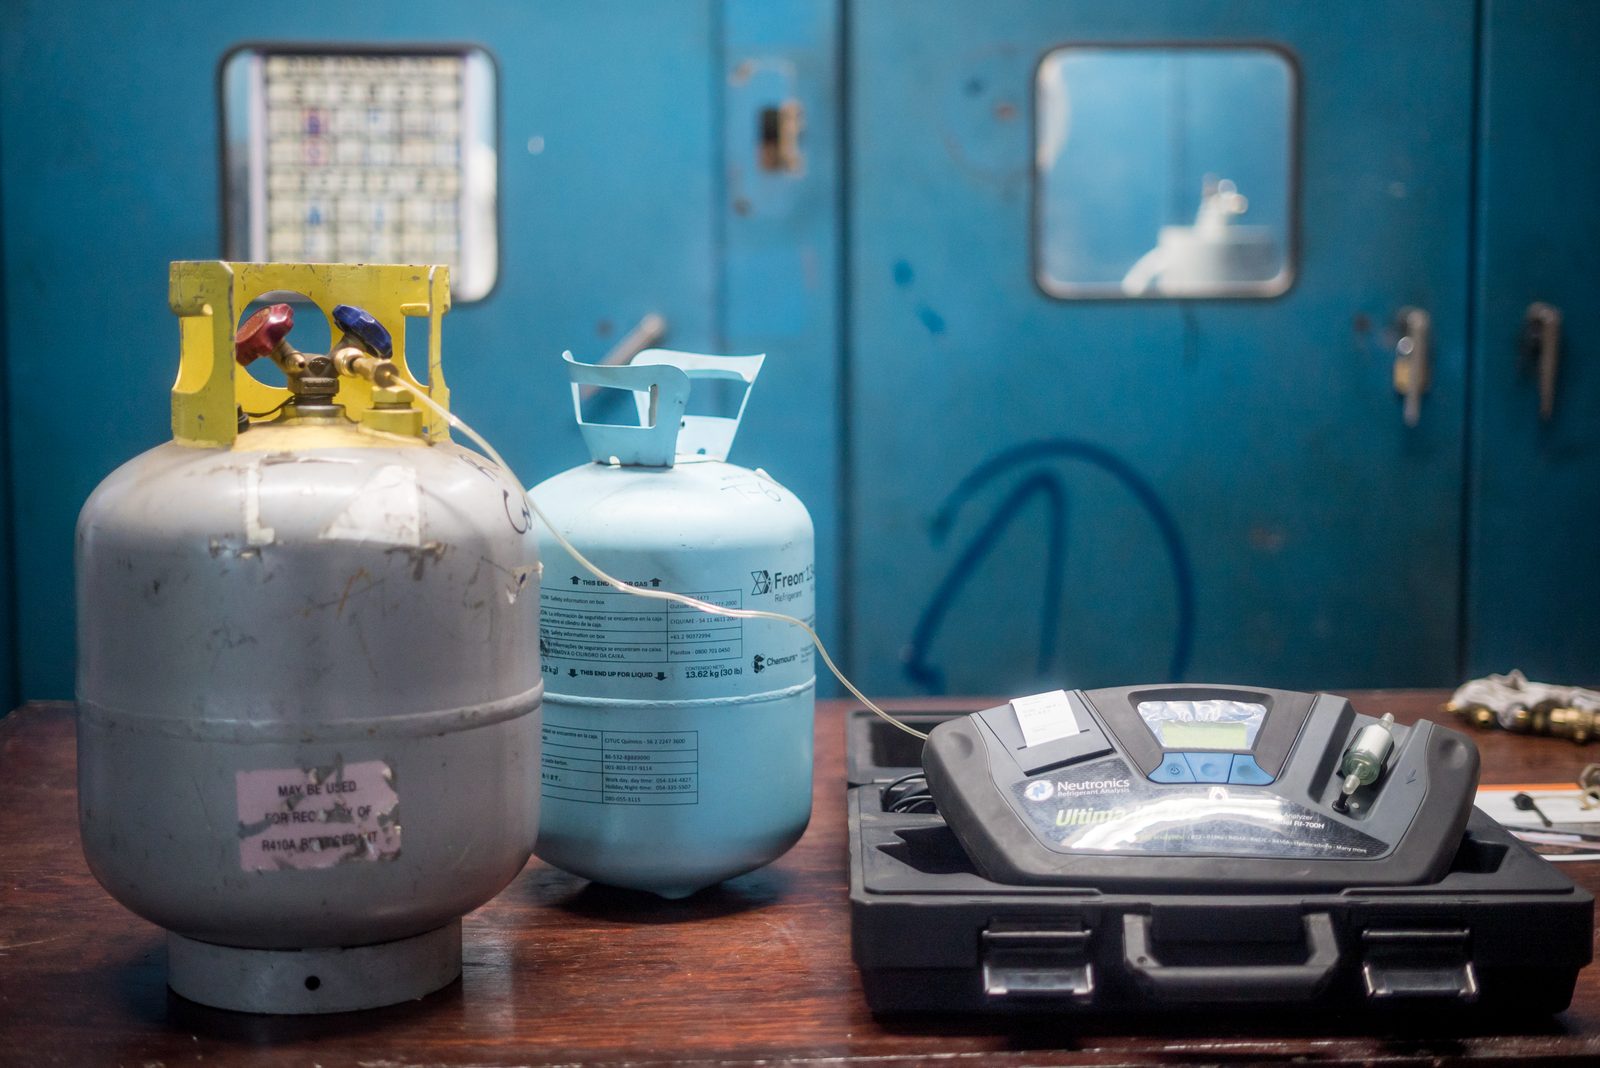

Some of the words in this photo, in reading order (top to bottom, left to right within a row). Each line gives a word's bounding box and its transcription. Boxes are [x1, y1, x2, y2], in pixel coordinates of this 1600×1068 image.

[774, 572, 804, 590] Freon
[686, 671, 709, 679] 13.62
[709, 669, 719, 678] kg
[720, 668, 733, 677] (30
[733, 667, 743, 675] lb)
[278, 784, 303, 797] MAY
[306, 783, 322, 795] BE
[326, 781, 357, 794] USED
[1057, 778, 1130, 792] Neutronics
[1057, 789, 1099, 798] Refrigerant
[1100, 786, 1130, 796] Analysis
[265, 812, 289, 825] FOR
[357, 805, 372, 818] OF
[1055, 806, 1126, 827] Ultima
[1283, 812, 1314, 821] Analyzer
[1293, 820, 1326, 830] RI-700H
[262, 839, 296, 852] R410A
[1336, 844, 1352, 853] Many
